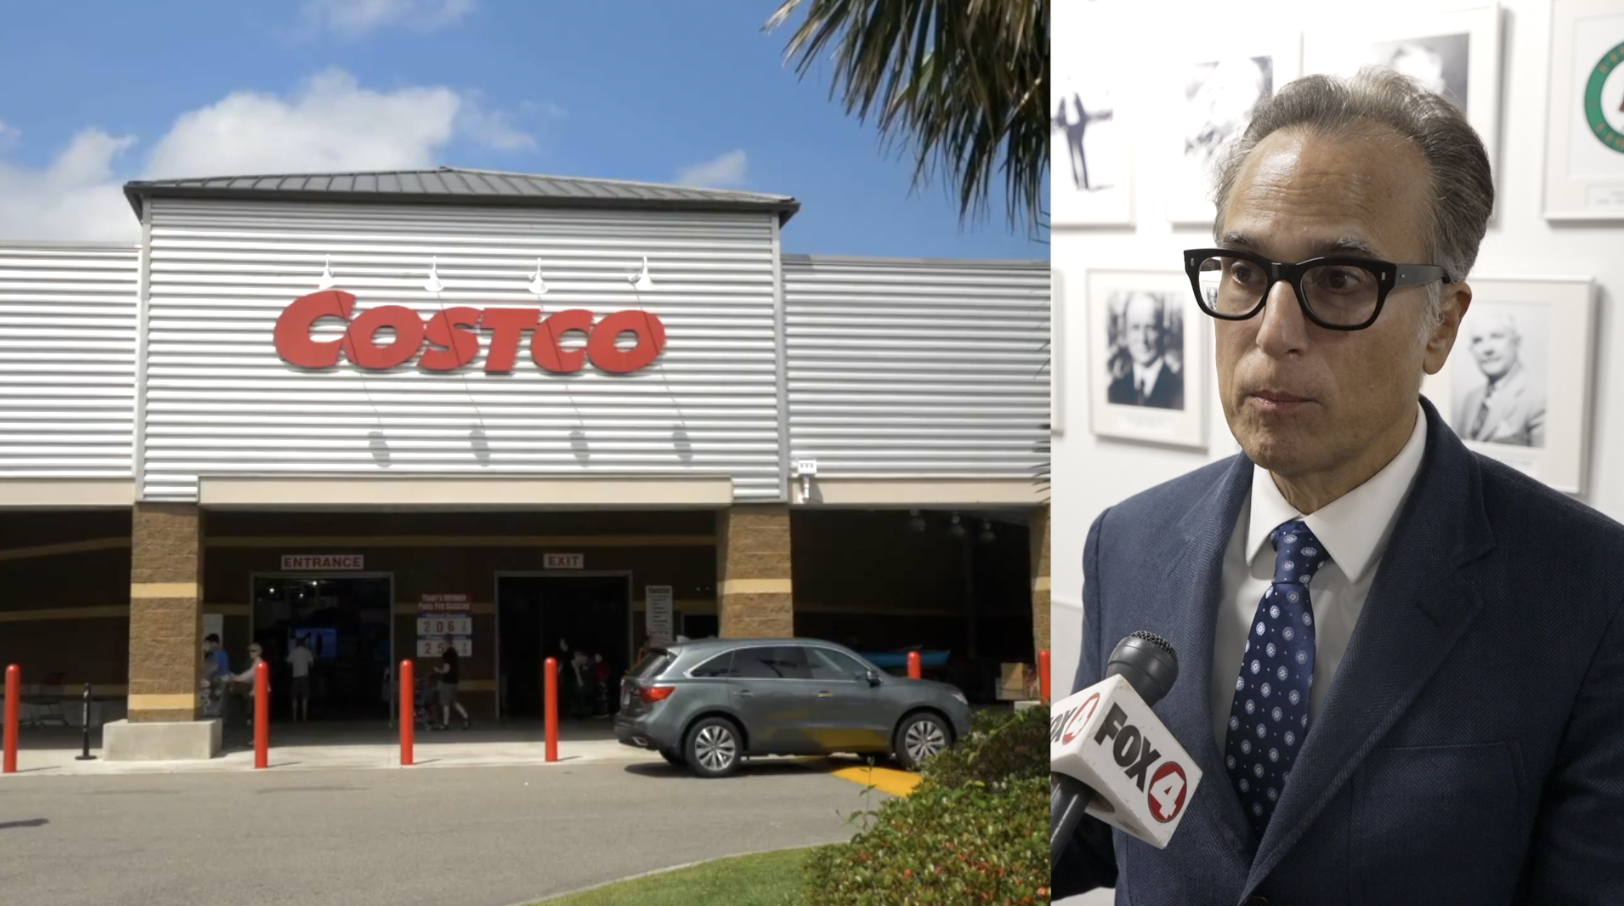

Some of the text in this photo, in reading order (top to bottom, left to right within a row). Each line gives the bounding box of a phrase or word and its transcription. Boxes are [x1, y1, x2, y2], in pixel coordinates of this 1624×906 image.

[273, 290, 667, 374] COSTCO
[284, 557, 362, 568] ENTRANCE
[548, 556, 580, 566] EXIT
[1093, 702, 1162, 793] FOX
[1149, 769, 1186, 821] 4
